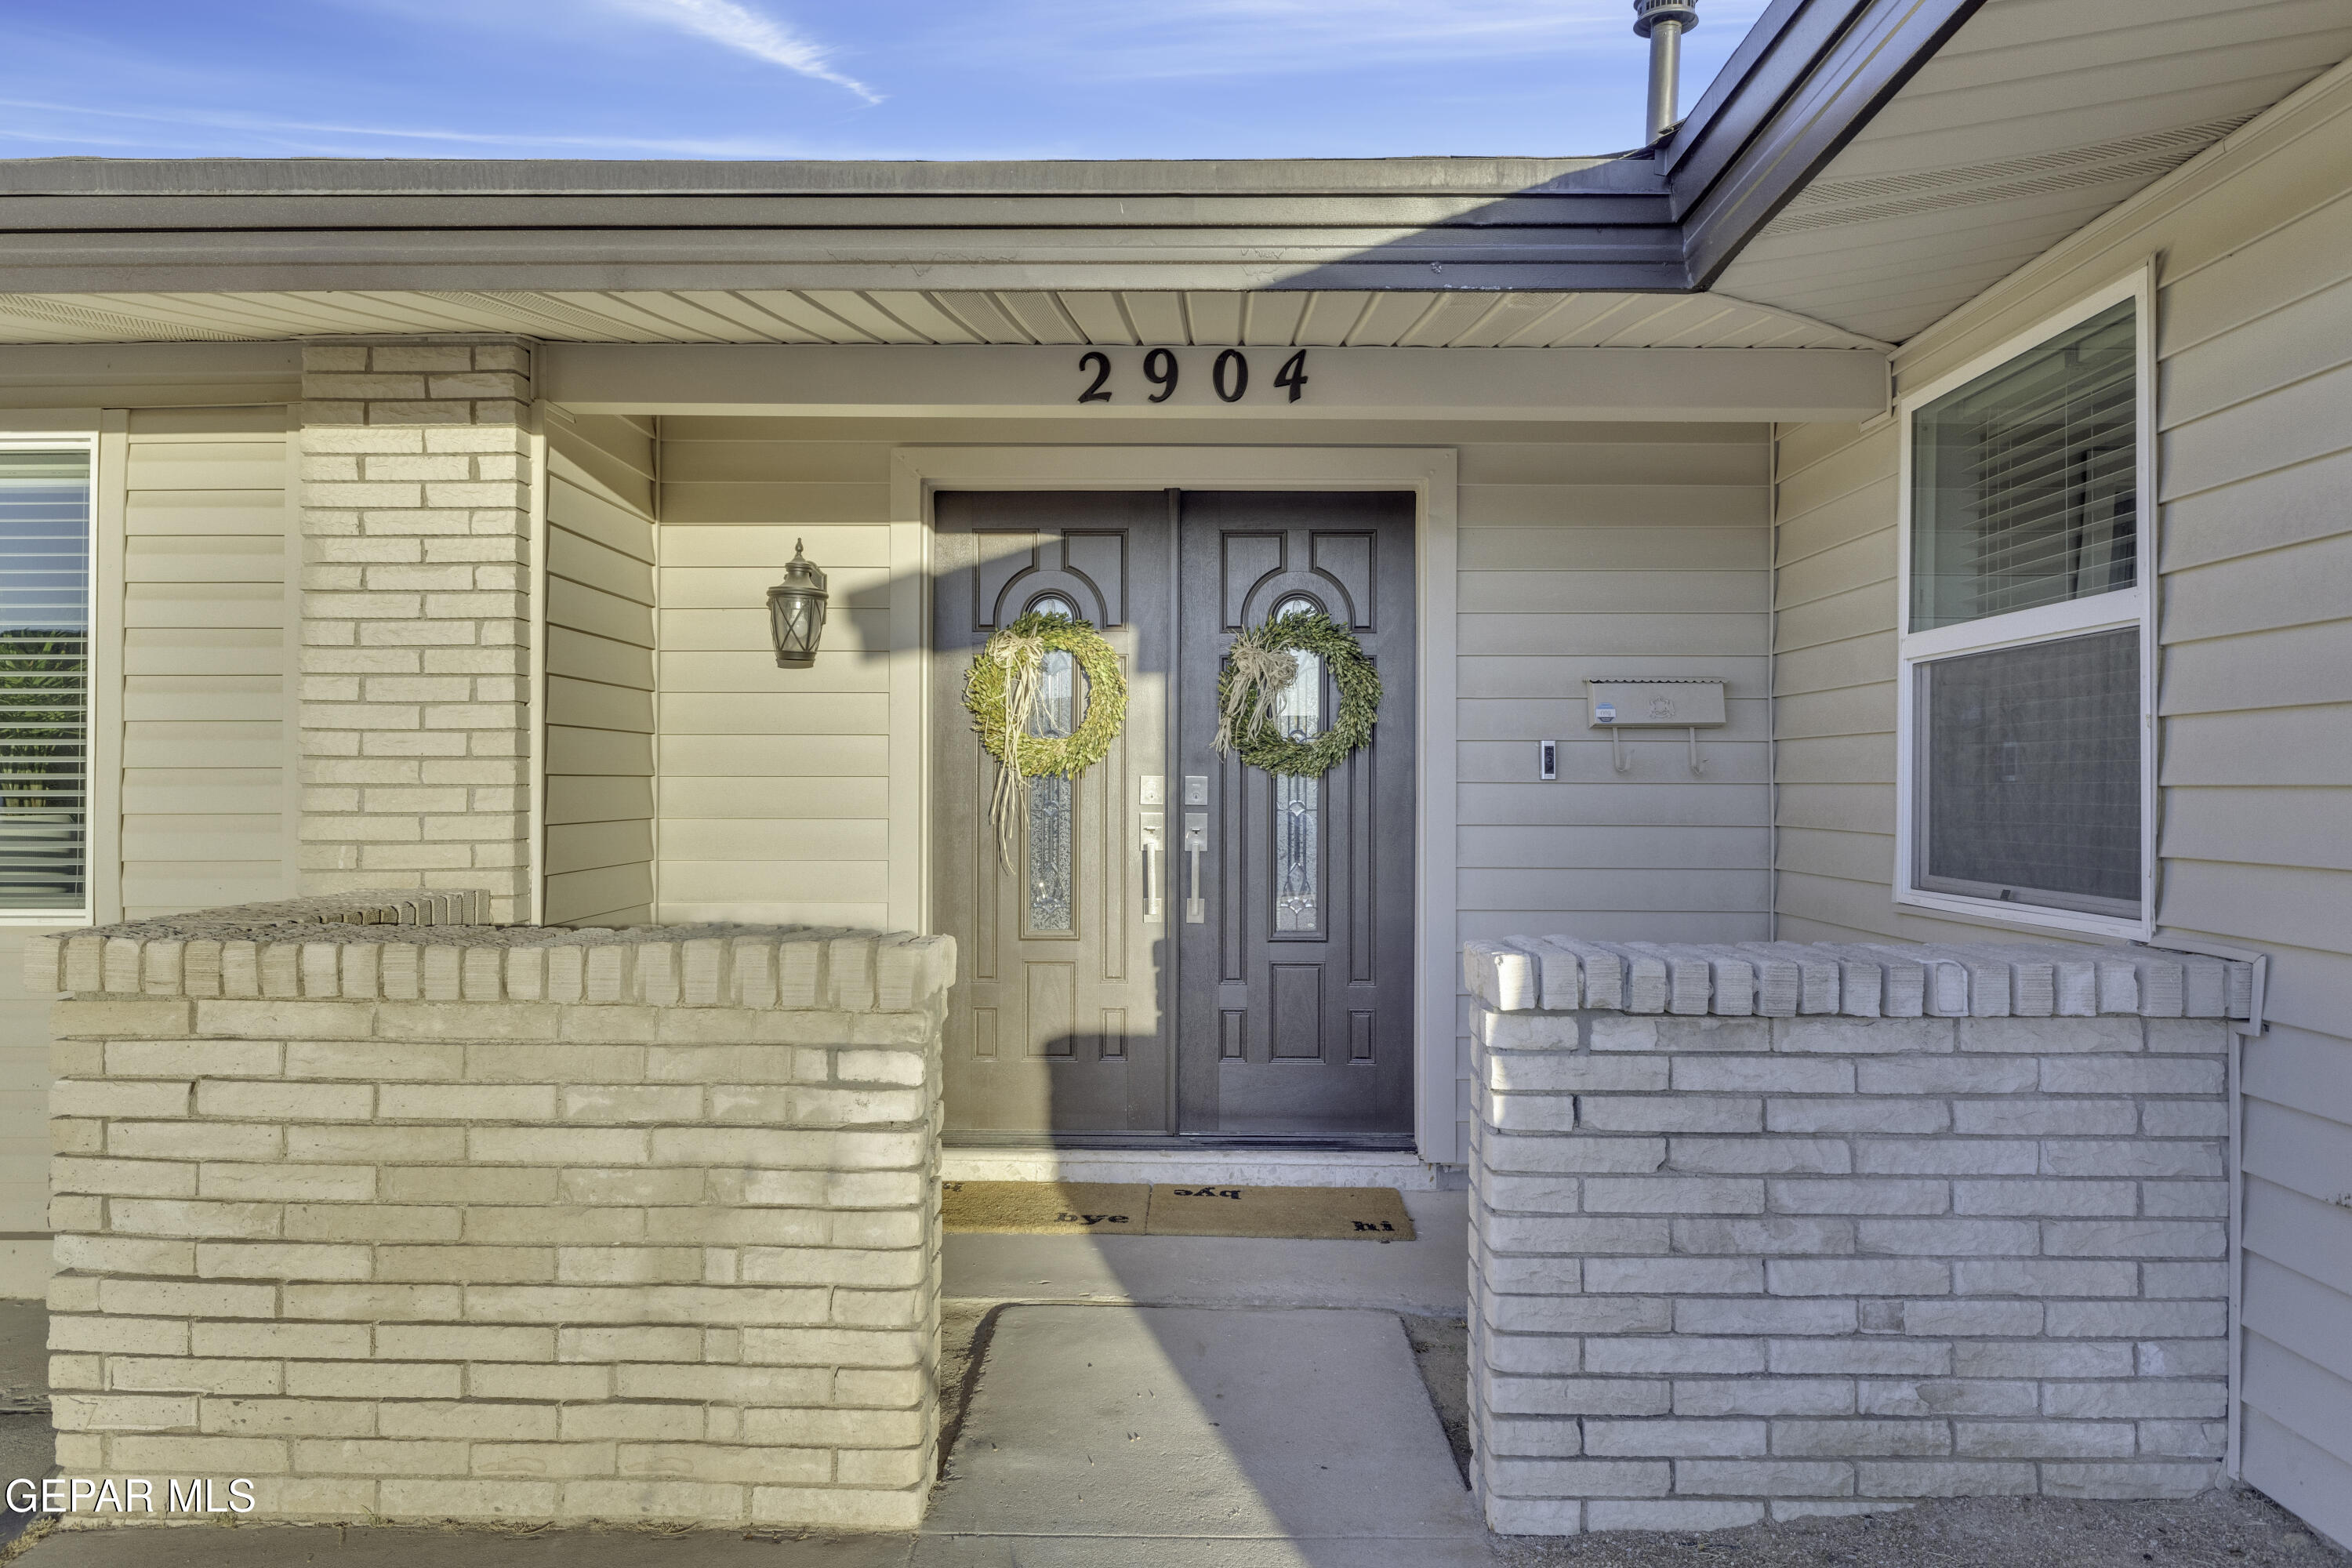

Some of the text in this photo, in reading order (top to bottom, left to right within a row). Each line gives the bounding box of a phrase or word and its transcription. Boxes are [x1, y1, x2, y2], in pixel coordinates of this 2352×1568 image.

[1077, 348, 1308, 404] 2904
[1174, 1187, 1242, 1200] bye
[1054, 1213, 1129, 1225] bye
[1352, 1221, 1396, 1232] hi
